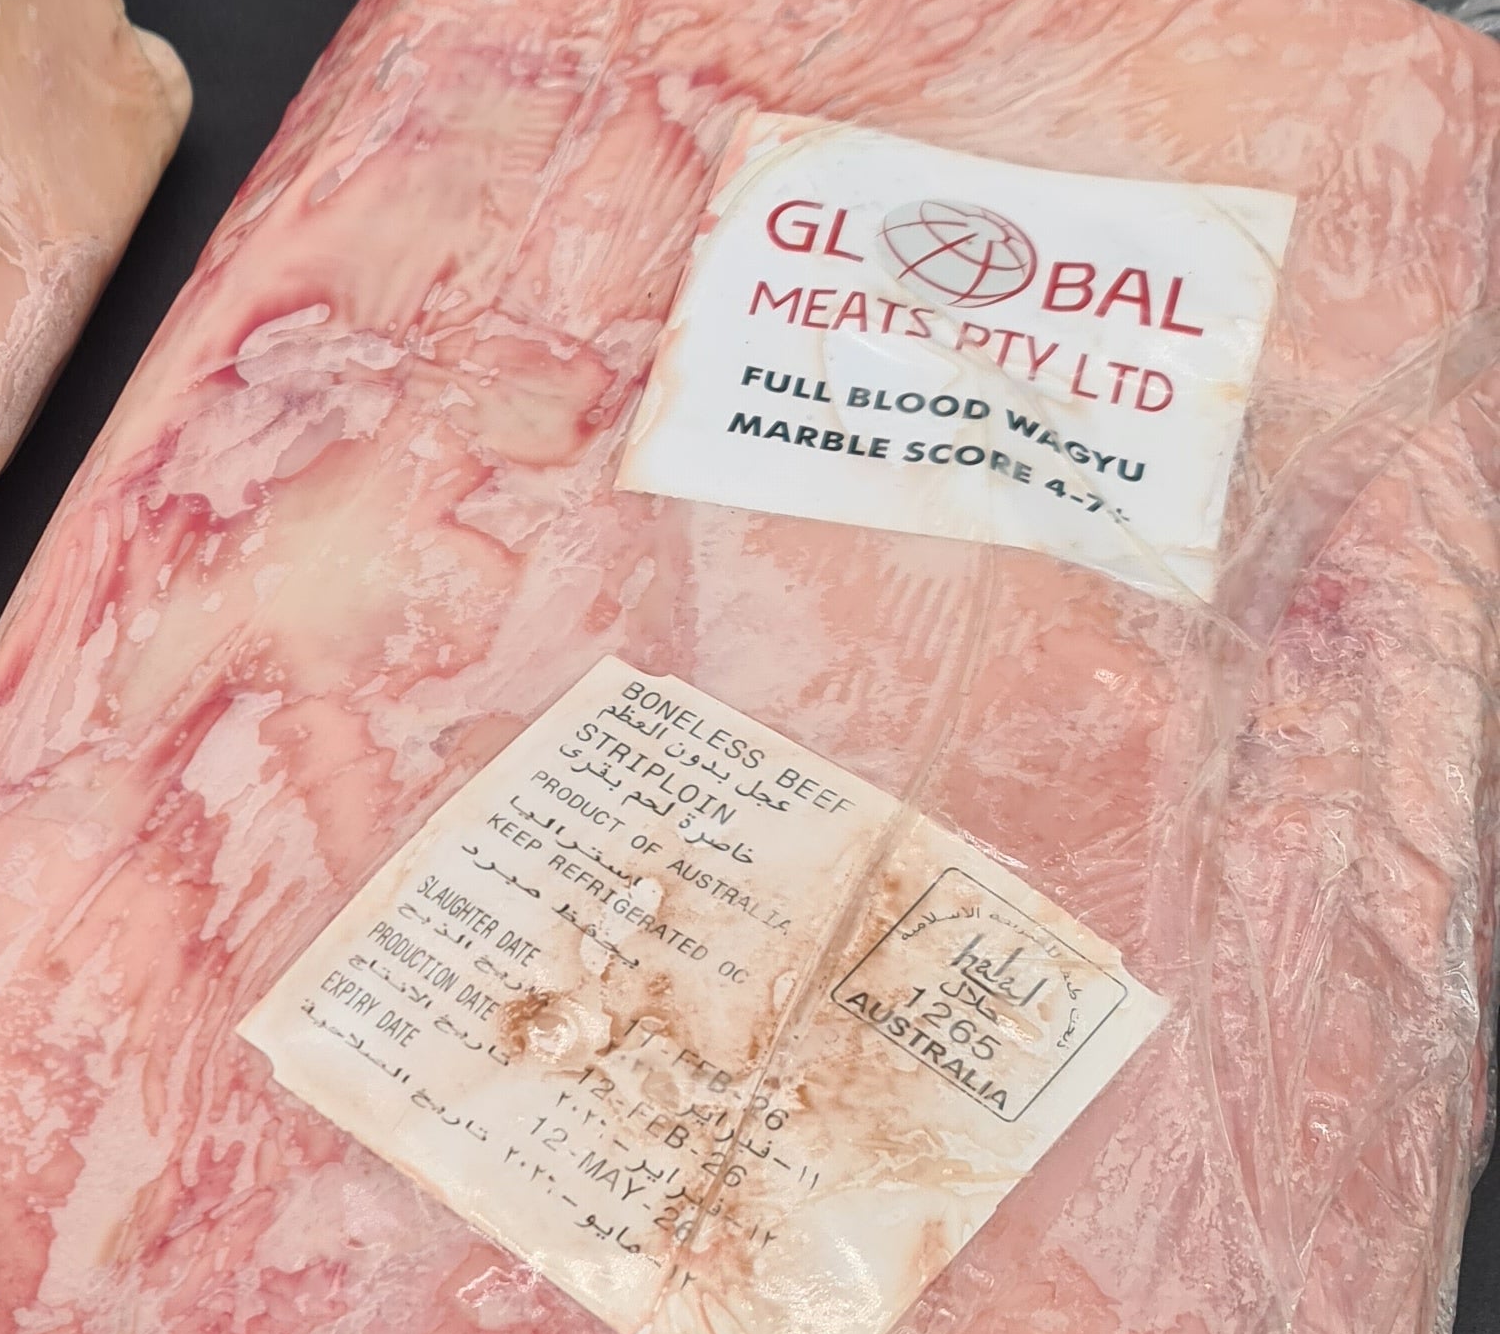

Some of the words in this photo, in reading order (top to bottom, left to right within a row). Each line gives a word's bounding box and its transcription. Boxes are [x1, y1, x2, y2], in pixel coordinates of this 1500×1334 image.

[749, 279, 936, 340] MEATS
[954, 321, 1060, 383] PTY
[1070, 353, 1175, 414] LTD
[726, 411, 891, 461] MARBLE
[902, 439, 1034, 485] SCORE
[740, 365, 833, 404] FULL
[846, 386, 991, 421] BLOOD
[1006, 408, 1147, 484] WAGYU
[596, 703, 669, 741] العظم
[620, 680, 766, 770] BONELESS
[775, 767, 857, 815] BEEF
[663, 743, 732, 785] بدون
[575, 722, 738, 826] STRIPLOIN
[620, 788, 677, 818] لحم
[734, 779, 791, 814] عجل
[530, 769, 627, 835] PRODUCT
[630, 833, 664, 857] OF
[665, 858, 793, 937] AUSTRALIA
[677, 812, 755, 865] خاصرة
[416, 874, 501, 940] SLAUGHTER
[494, 929, 542, 968] DATE
[485, 812, 544, 853] KEEP
[547, 853, 709, 962] REFRIGERATED
[319, 969, 382, 1018] EXPIRY
[375, 1009, 421, 1049] DATE
[366, 920, 461, 994] PRODUCTION
[454, 983, 502, 1023] DATE
[950, 932, 1050, 1007] halal
[844, 991, 1009, 1111] AUSTRALIA
[904, 985, 1003, 1062] 1265
